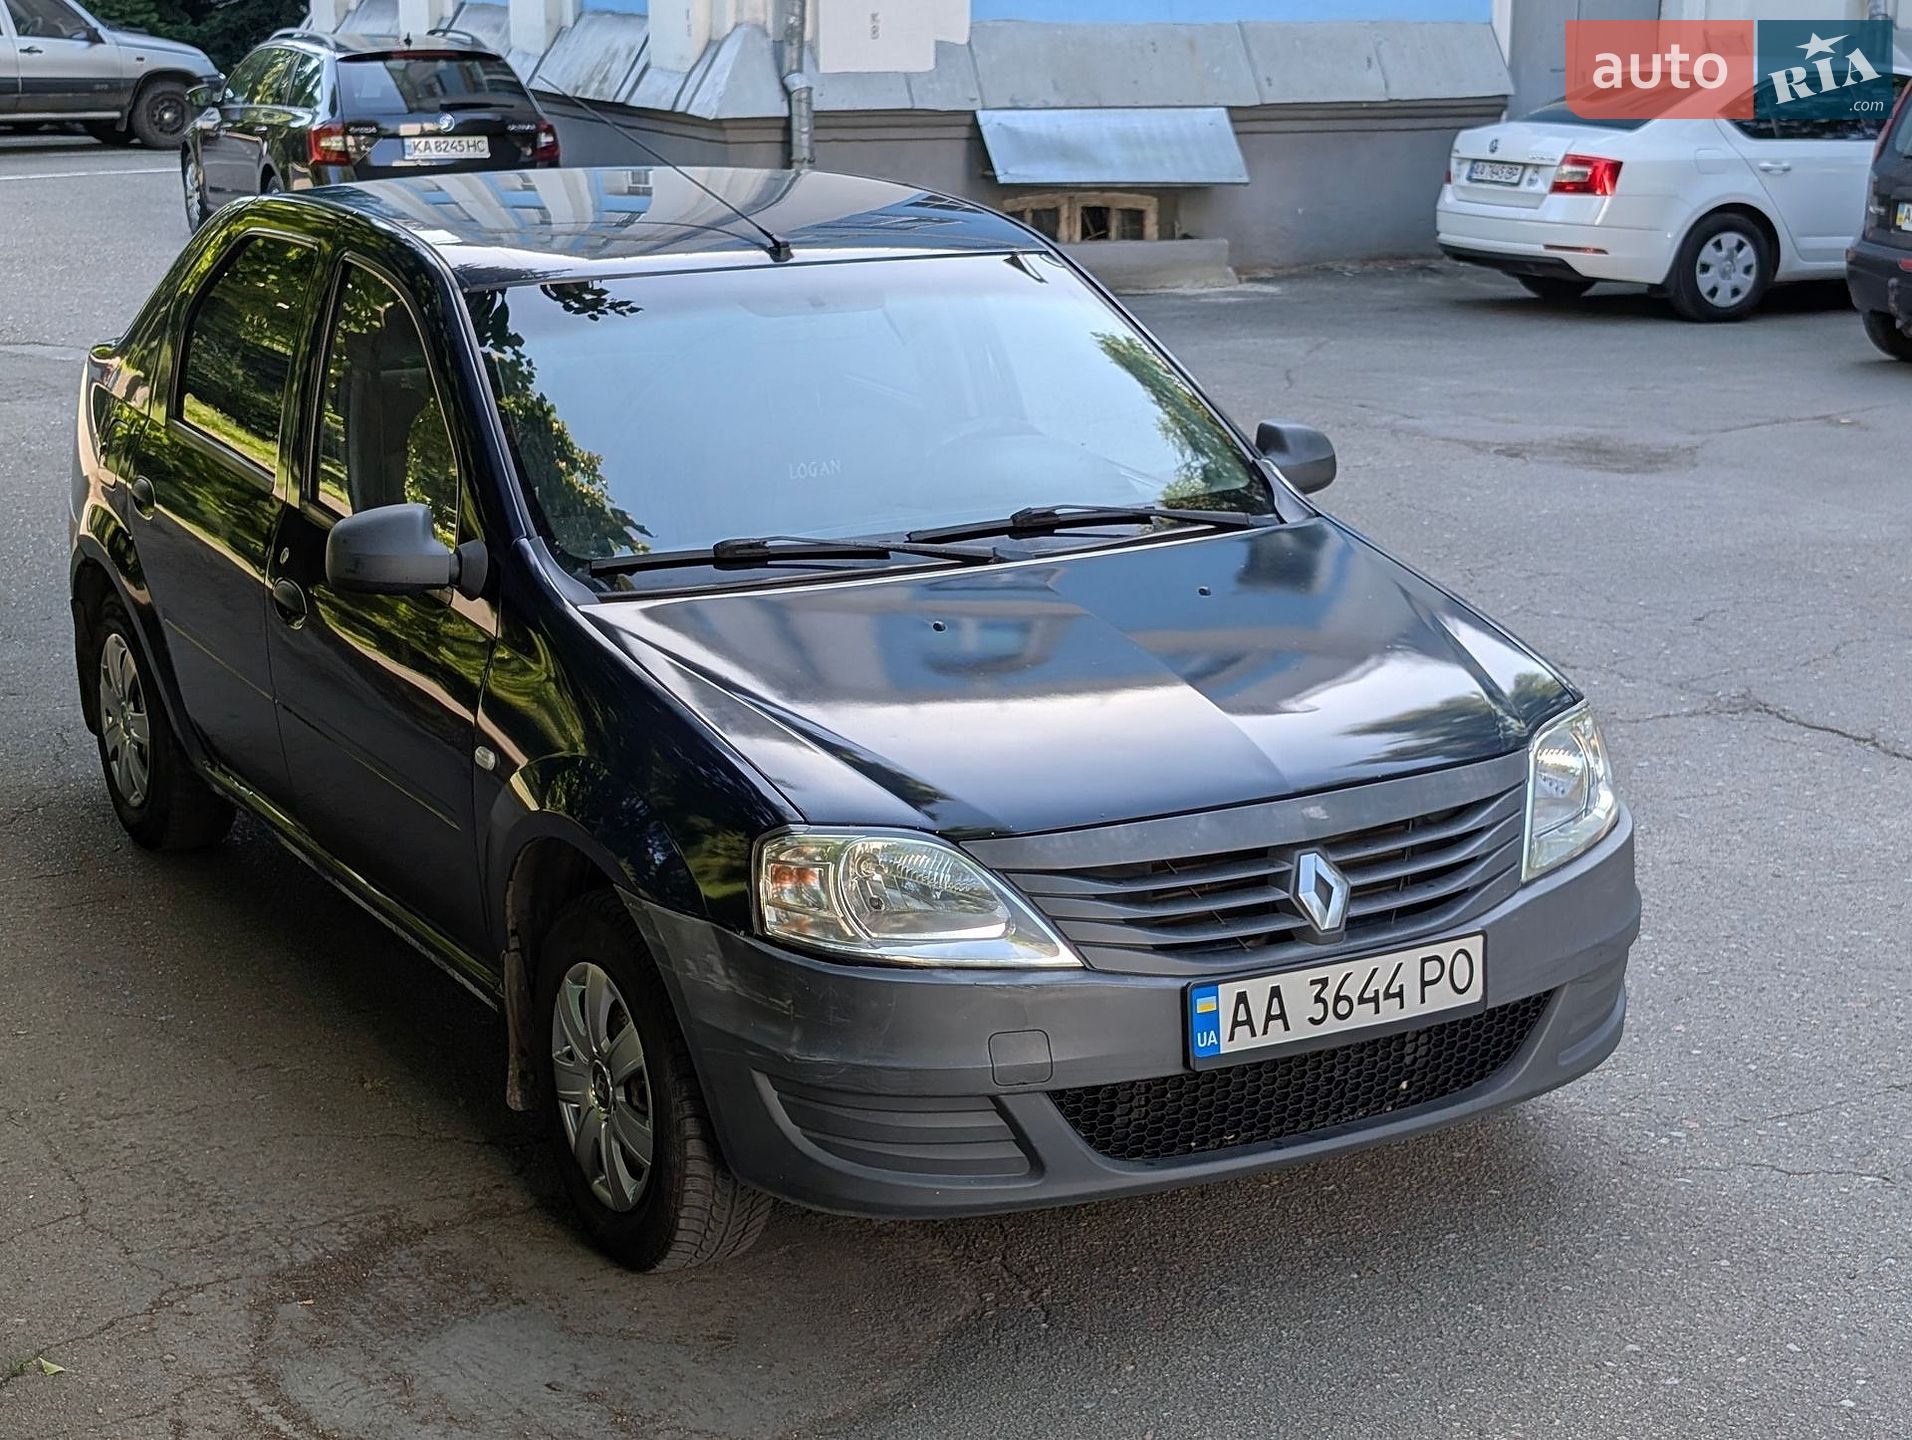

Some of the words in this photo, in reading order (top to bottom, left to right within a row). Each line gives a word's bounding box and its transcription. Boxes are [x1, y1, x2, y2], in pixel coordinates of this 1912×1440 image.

[788, 459, 841, 480] LOGAN
[1228, 985, 1290, 1042] AA
[1307, 962, 1404, 1026] 3644
[1420, 948, 1474, 1004] PO
[1197, 1030, 1218, 1048] UA
